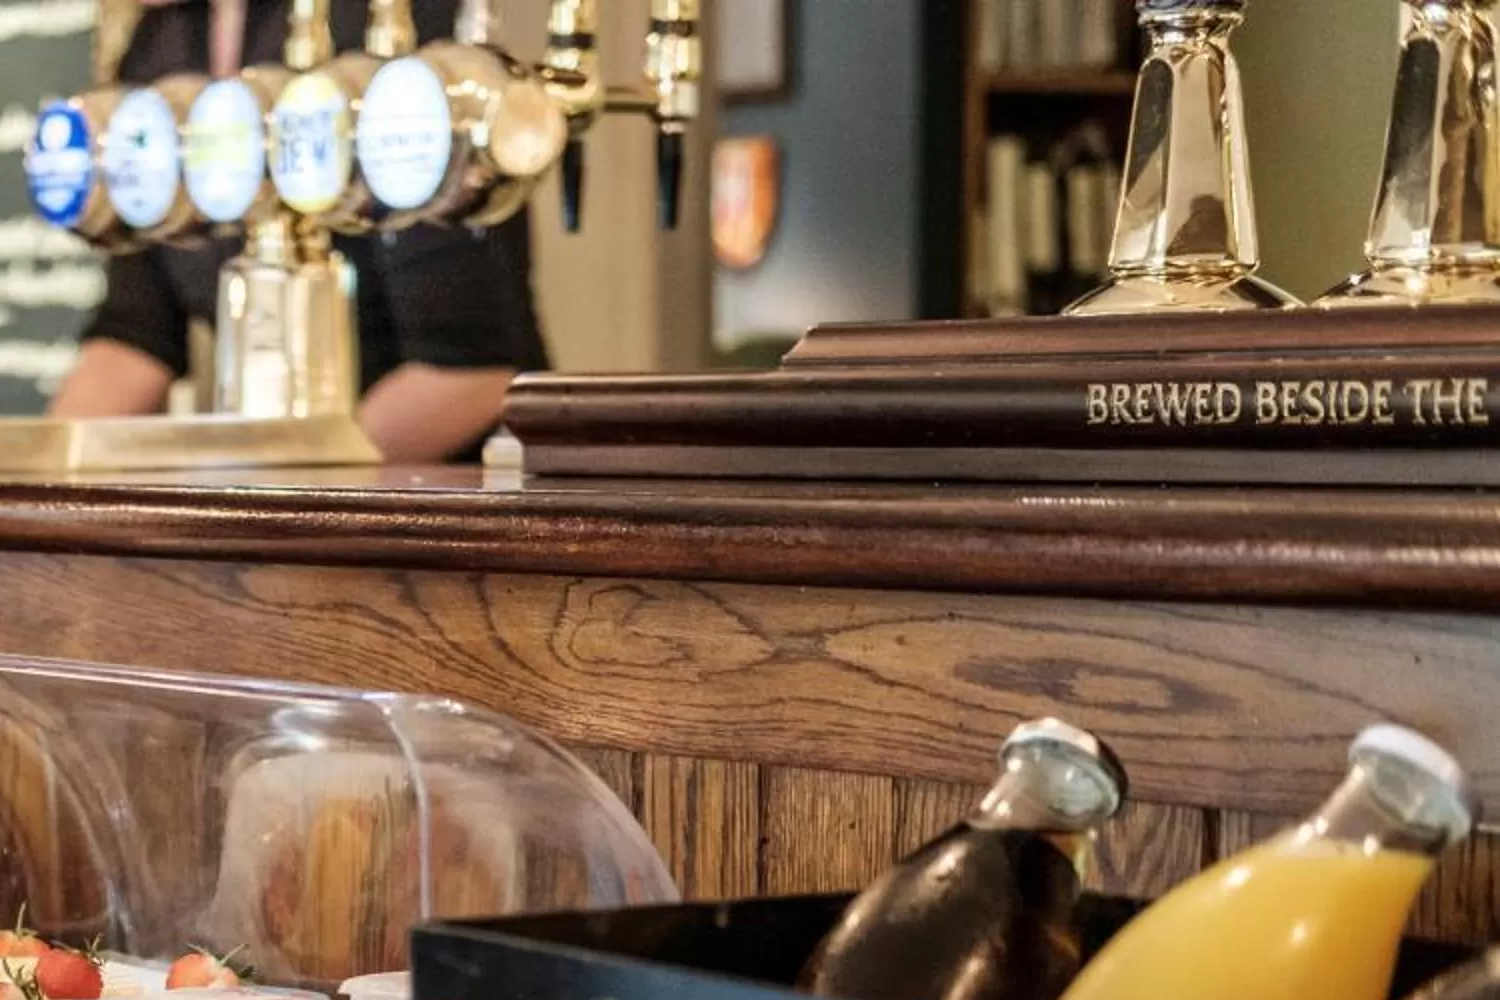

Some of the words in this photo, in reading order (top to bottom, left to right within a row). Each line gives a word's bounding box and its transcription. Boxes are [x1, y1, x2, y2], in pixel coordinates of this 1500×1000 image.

[1085, 381, 1241, 427] BREWED
[1255, 379, 1394, 426] BESIDE
[1404, 377, 1490, 425] THE
